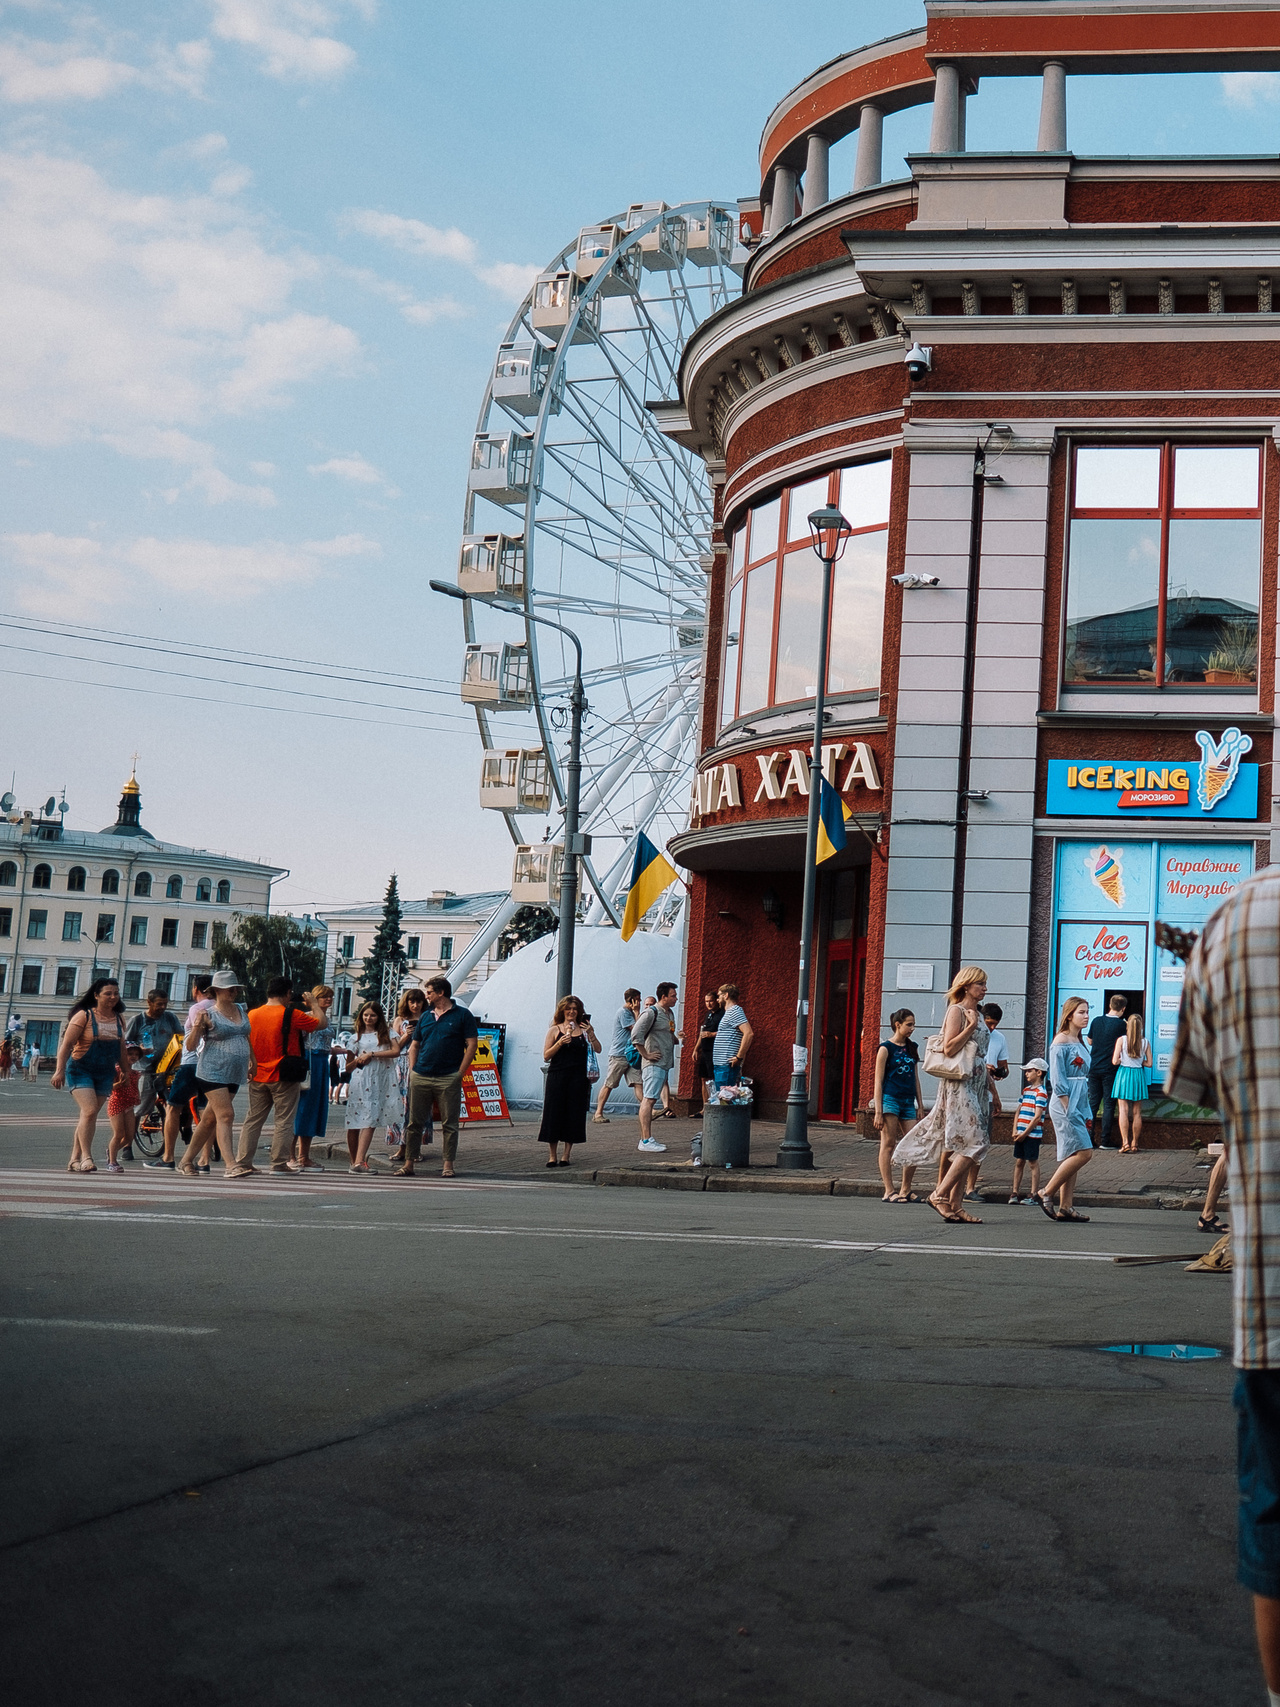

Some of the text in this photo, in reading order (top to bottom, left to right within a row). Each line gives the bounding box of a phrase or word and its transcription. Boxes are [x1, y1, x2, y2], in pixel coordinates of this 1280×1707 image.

[691, 742, 884, 819] АТА ХАТА
[1067, 765, 1190, 791] ICEKING
[1130, 793, 1176, 802] МОРОЗИВО
[1093, 926, 1130, 950] Ice
[1075, 945, 1128, 962] Cream
[1084, 964, 1123, 980] Time
[474, 1073, 496, 1082] 2630
[479, 1088, 500, 1098] 2980
[485, 1105, 501, 1113] 408
